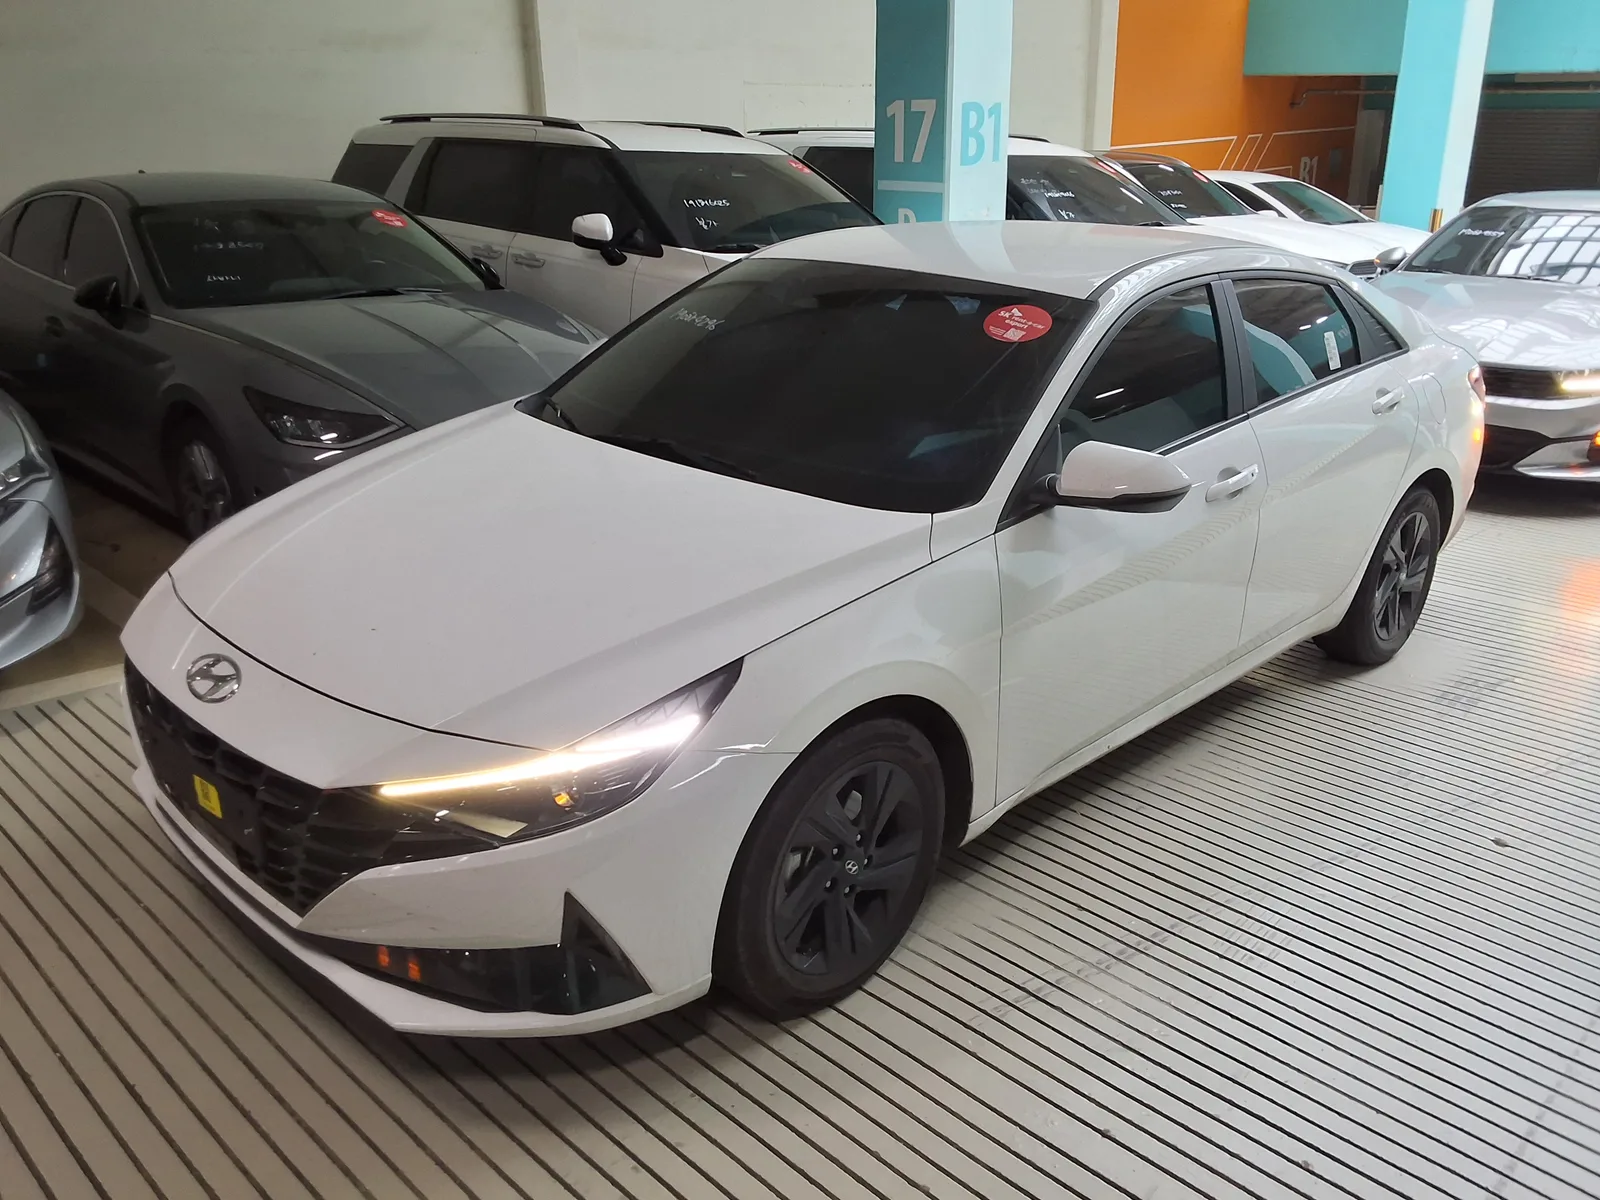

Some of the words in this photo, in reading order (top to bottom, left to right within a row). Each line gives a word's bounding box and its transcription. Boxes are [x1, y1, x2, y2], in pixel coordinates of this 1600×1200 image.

[886, 99, 937, 163] 17
[960, 101, 1001, 166] B1
[1299, 156, 1319, 185] B1
[998, 310, 1013, 319] SK
